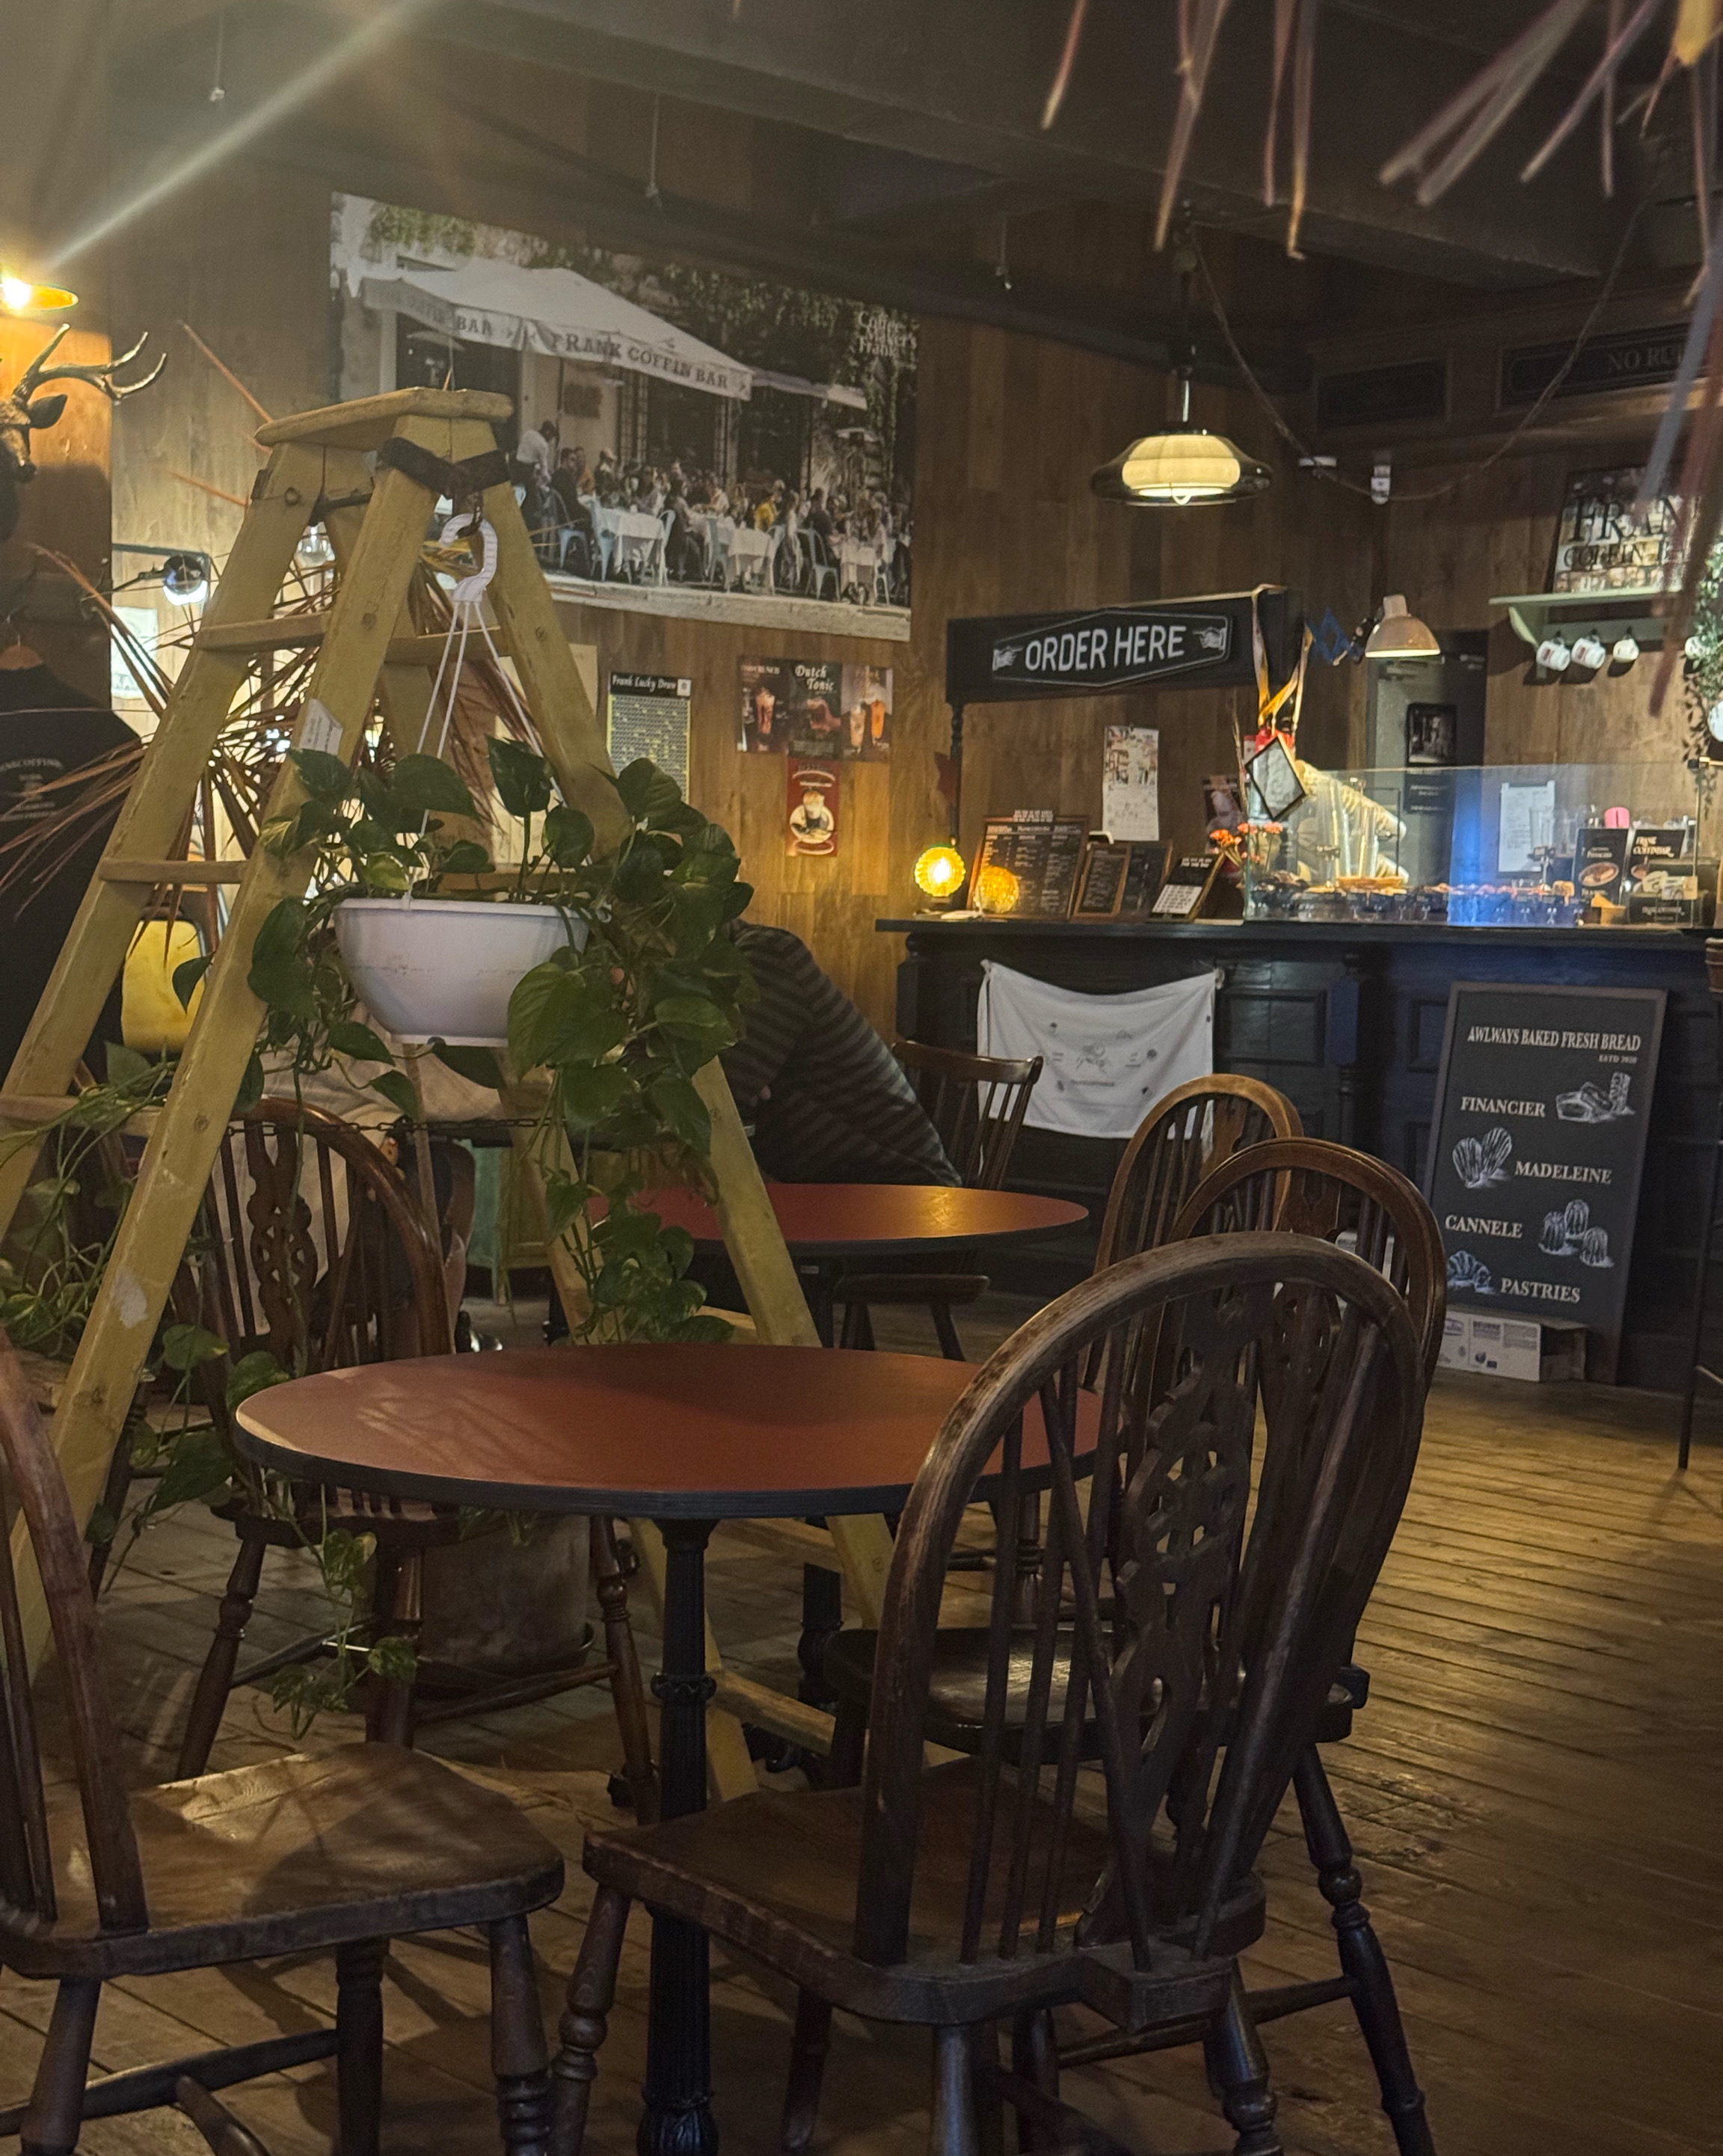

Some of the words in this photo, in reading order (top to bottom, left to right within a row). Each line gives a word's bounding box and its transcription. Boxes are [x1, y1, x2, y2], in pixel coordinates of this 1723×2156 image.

[628, 346, 691, 377] COFFIN
[695, 367, 728, 390] BAR
[1025, 629, 1108, 672] ORDER
[1114, 625, 1187, 668] HERE
[612, 674, 633, 687] Frank
[634, 676, 657, 693] Lucky
[794, 664, 827, 680] Dutch
[807, 678, 835, 691] Tonic
[1467, 1025, 1520, 1045] AWLWAYS
[1520, 1028, 1559, 1048] BAKED
[1561, 1031, 1600, 1050] FRESH
[1601, 1034, 1641, 1051] BREAD
[1460, 1096, 1546, 1117] FINANCIER
[1514, 1161, 1612, 1185] MADELEINE
[1445, 1214, 1523, 1238] CANNELE
[1500, 1277, 1581, 1304] PASTRIES
